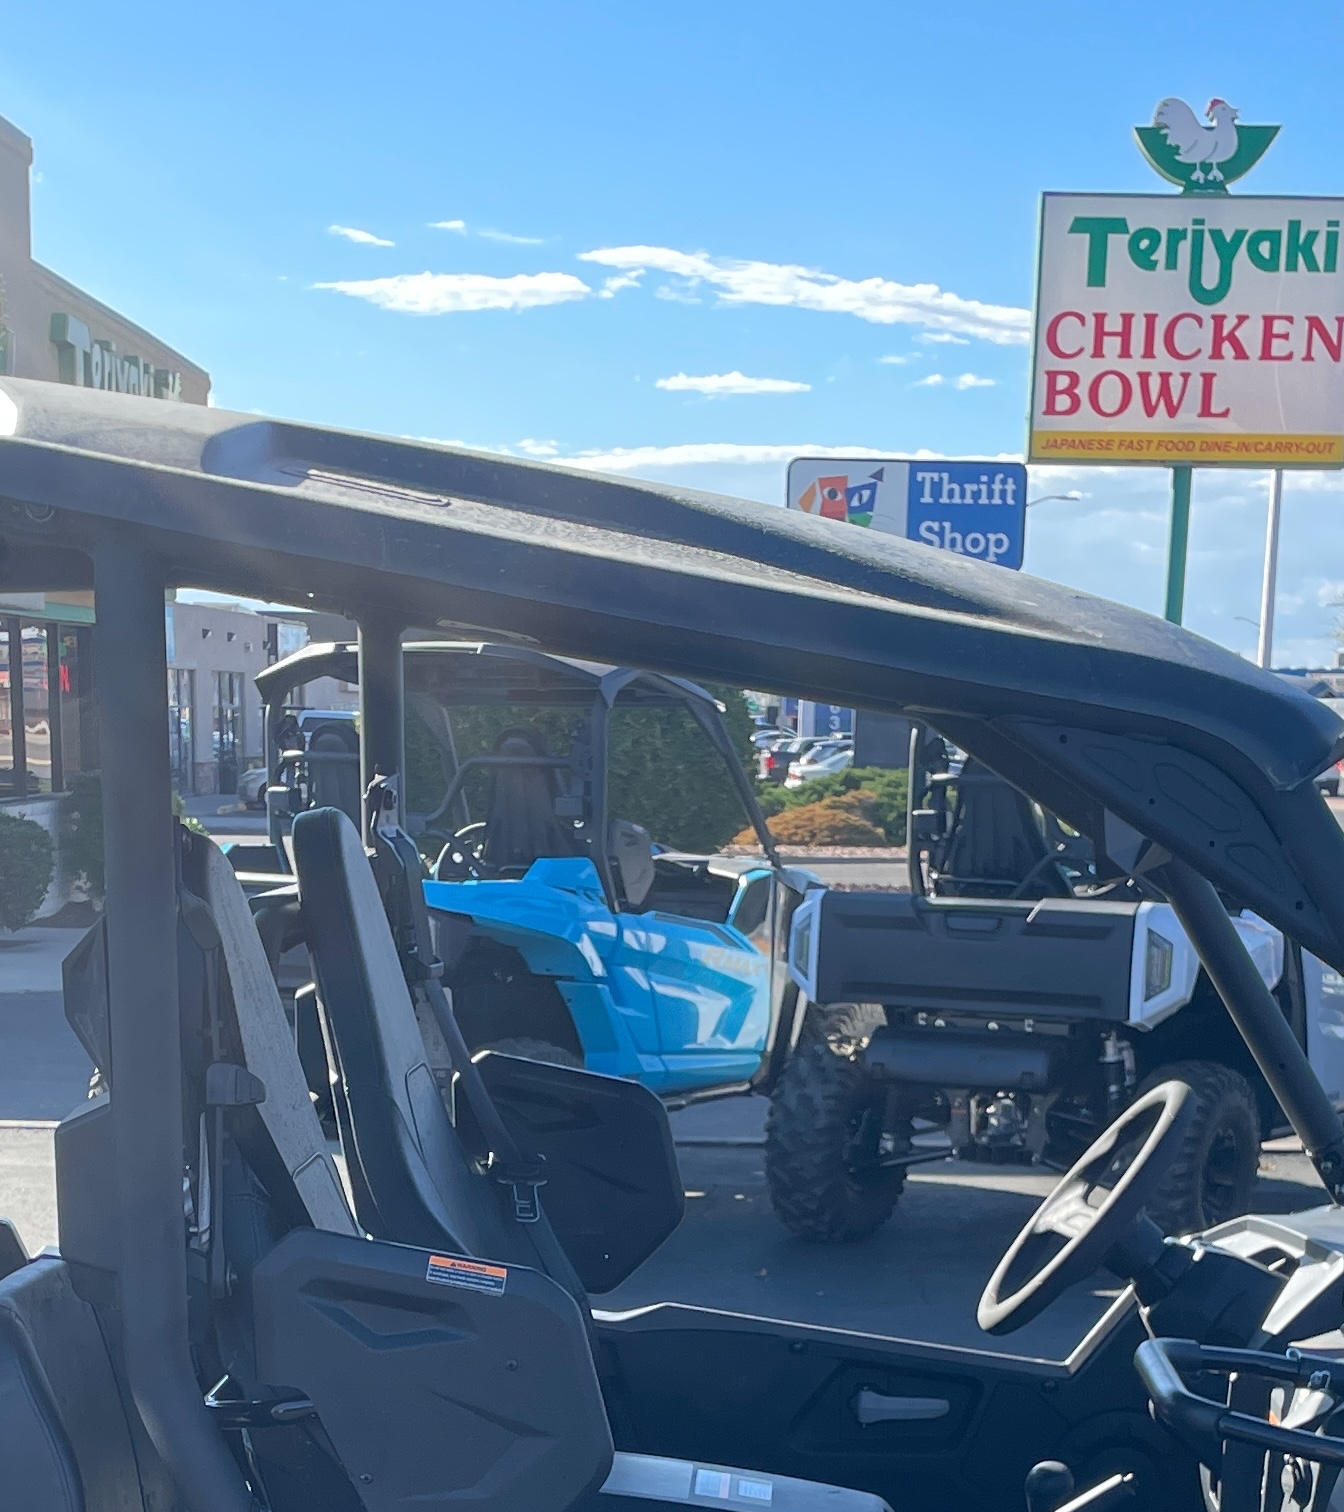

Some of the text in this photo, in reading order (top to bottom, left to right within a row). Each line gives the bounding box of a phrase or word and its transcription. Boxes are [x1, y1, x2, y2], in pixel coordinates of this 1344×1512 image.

[1067, 216, 1340, 306] Teriyaki
[1041, 369, 1231, 419] BOWL
[1041, 437, 1115, 452] JAPANESE
[1117, 439, 1153, 452] FAST
[1155, 440, 1196, 453] FOOD
[915, 471, 1017, 506] Thrift
[918, 520, 1010, 562] Shop
